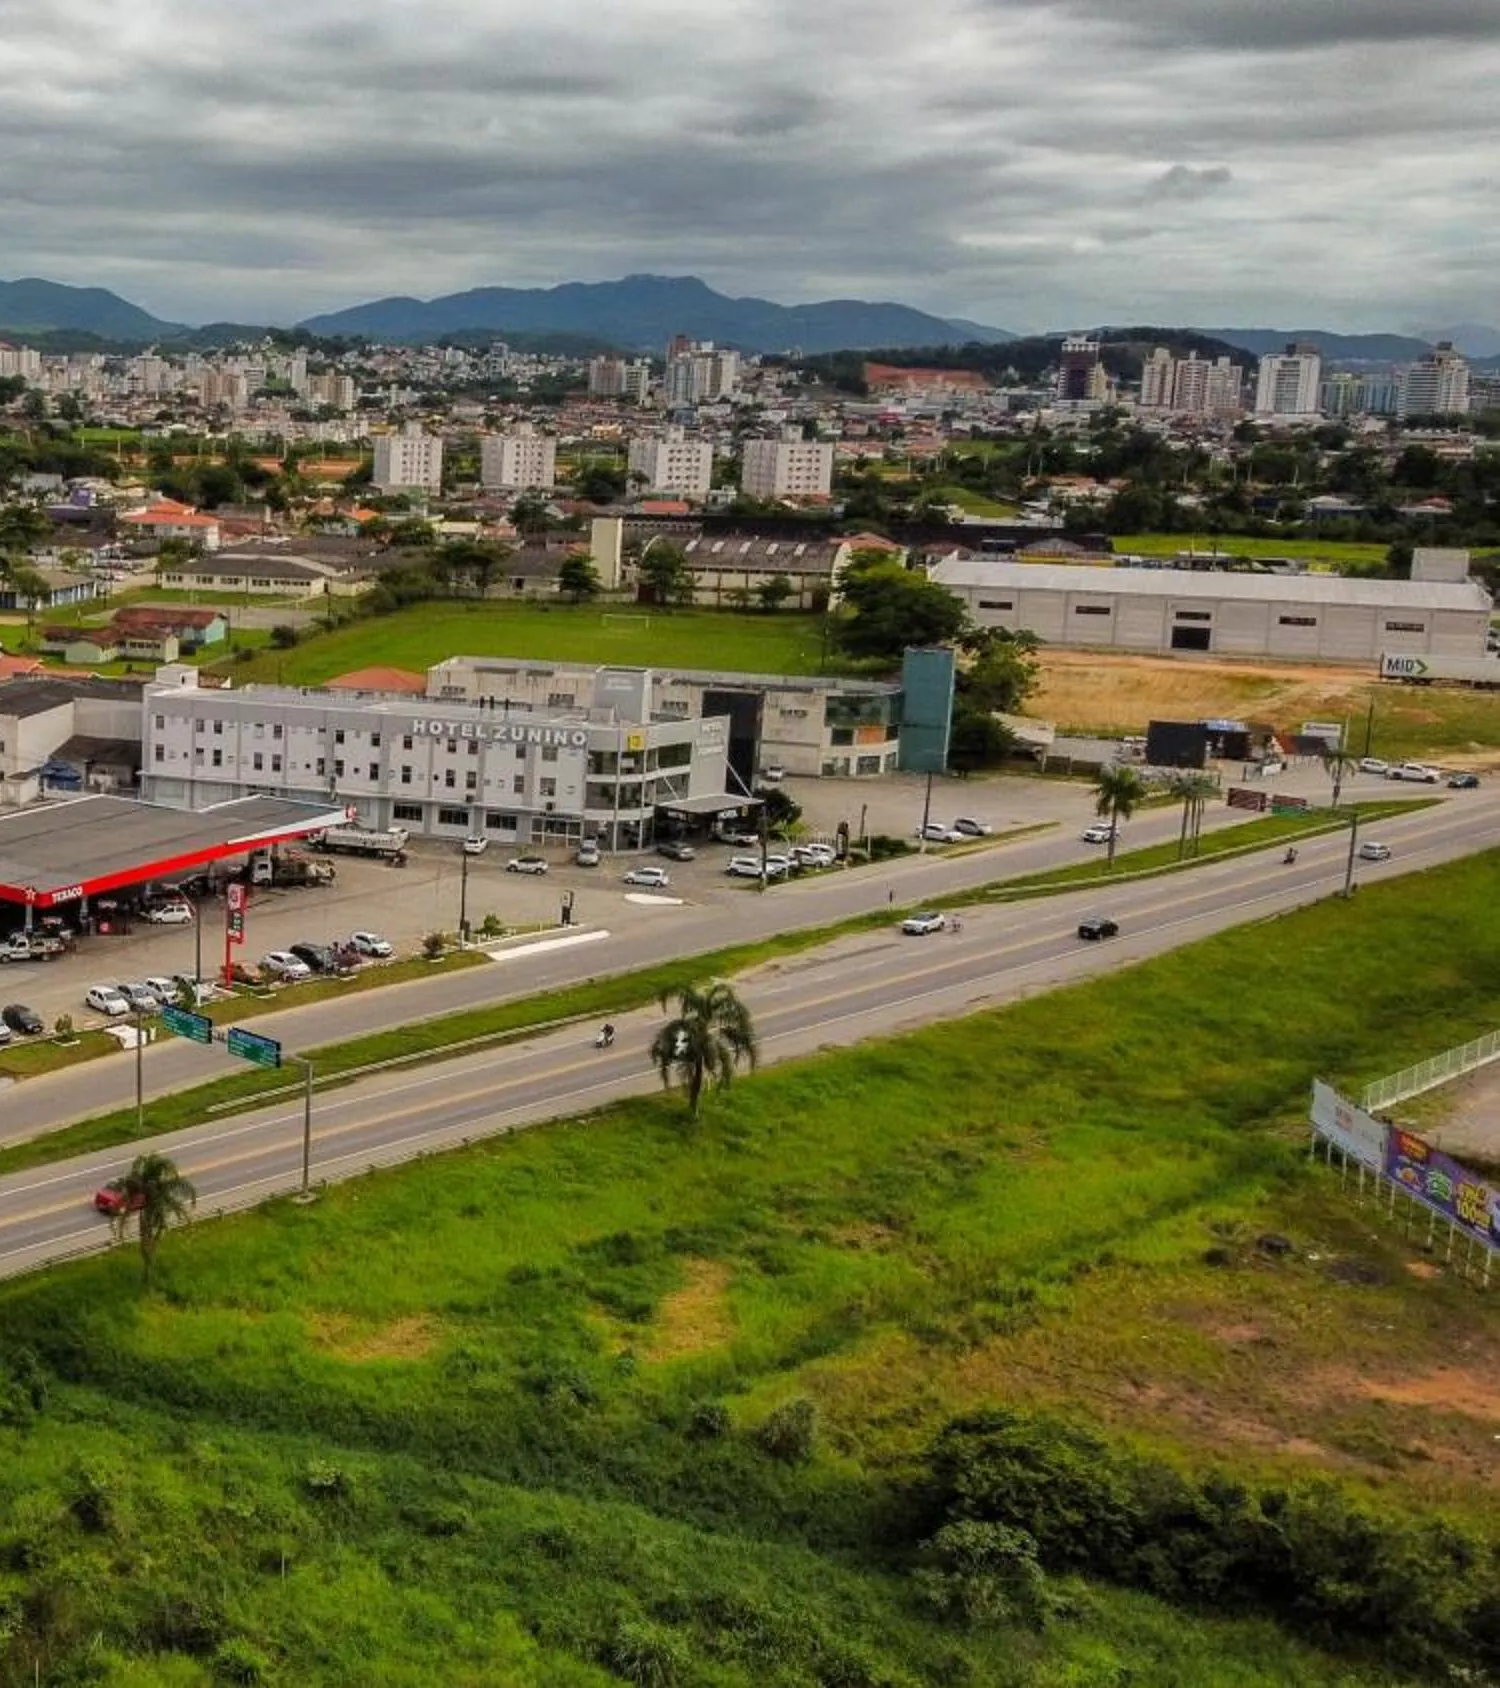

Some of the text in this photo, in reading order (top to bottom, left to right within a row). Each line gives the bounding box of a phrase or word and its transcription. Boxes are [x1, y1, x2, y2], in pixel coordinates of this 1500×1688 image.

[413, 719, 587, 746] HOTEL ZUNINO
[51, 886, 83, 904] TEXACO
